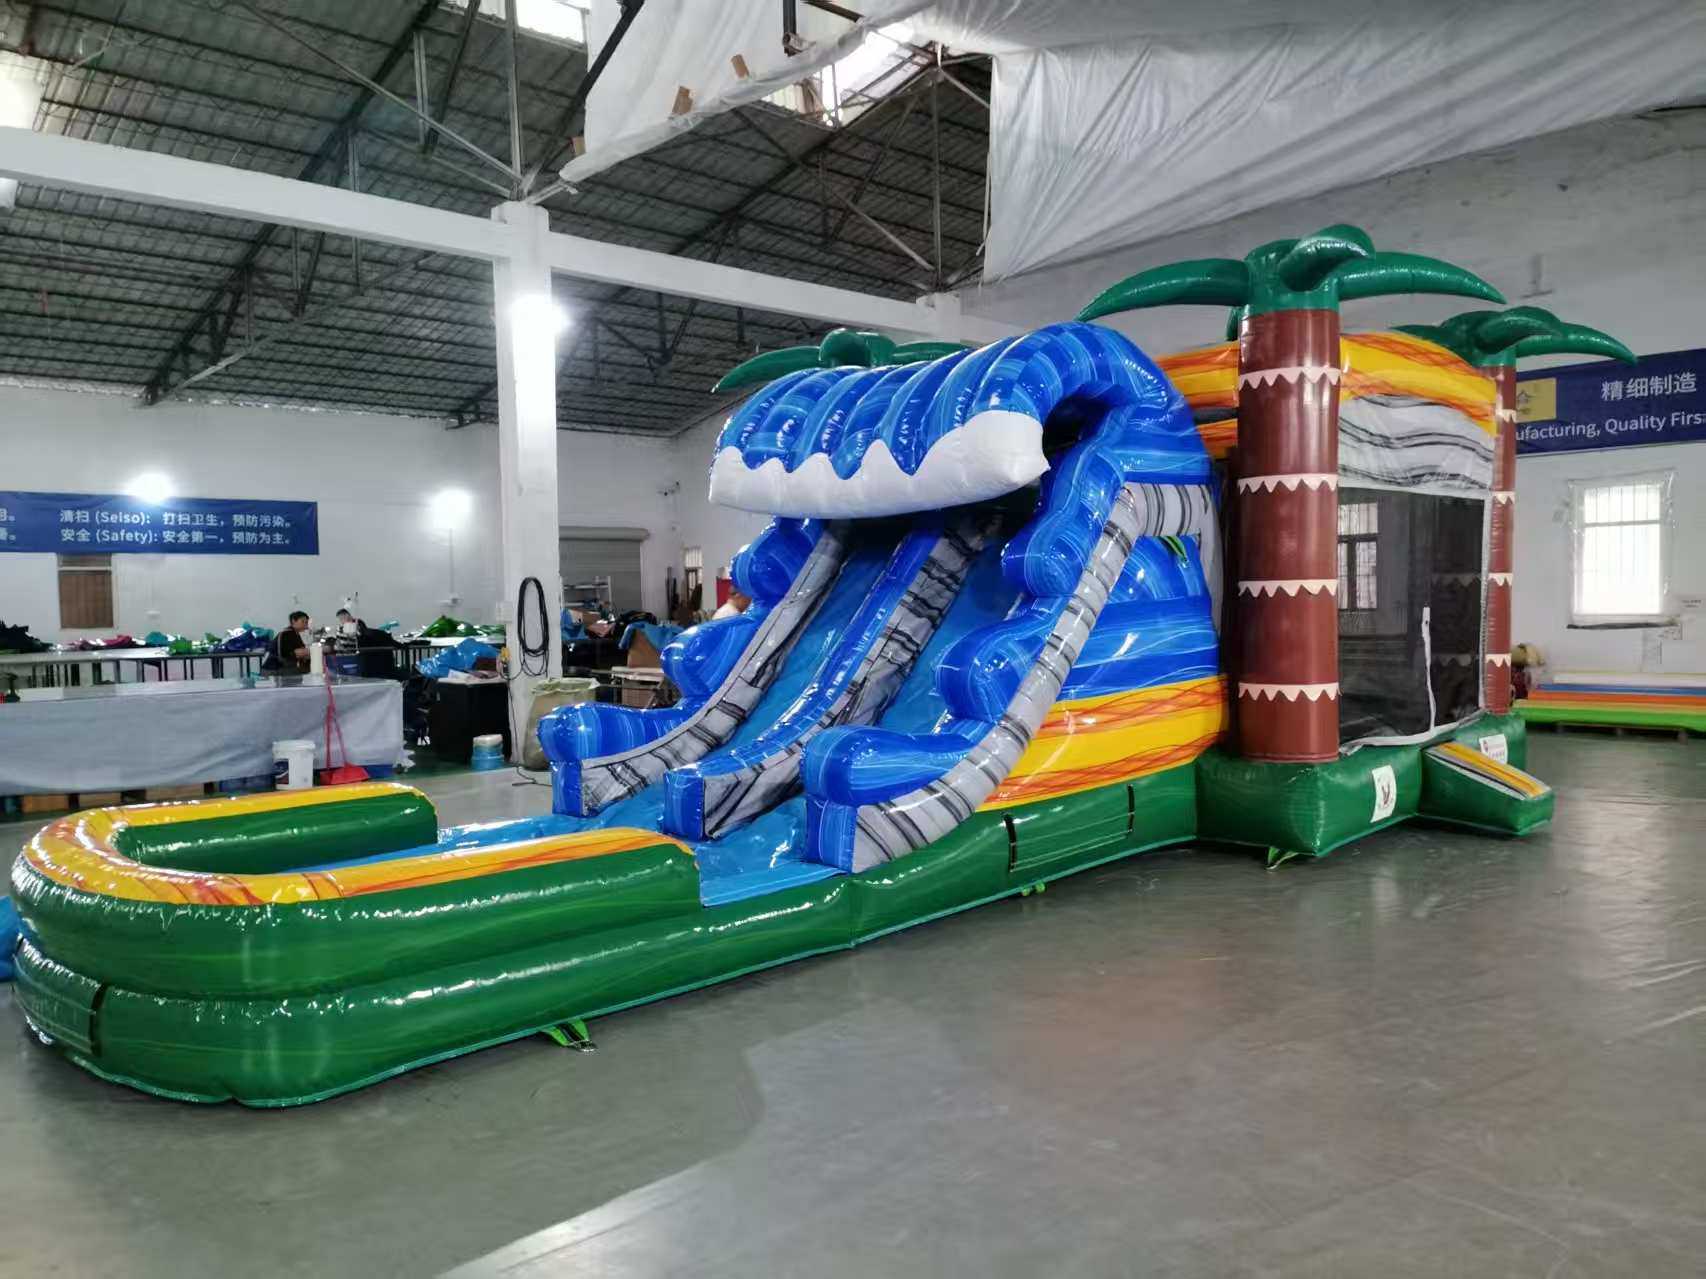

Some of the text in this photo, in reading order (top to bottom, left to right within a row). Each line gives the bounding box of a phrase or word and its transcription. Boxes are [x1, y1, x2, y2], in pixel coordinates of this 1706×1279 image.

[1601, 372, 1697, 400] 精细制造
[1605, 415, 1666, 435] Quality
[60, 509, 89, 524] 清扫
[60, 527, 90, 542] 安全
